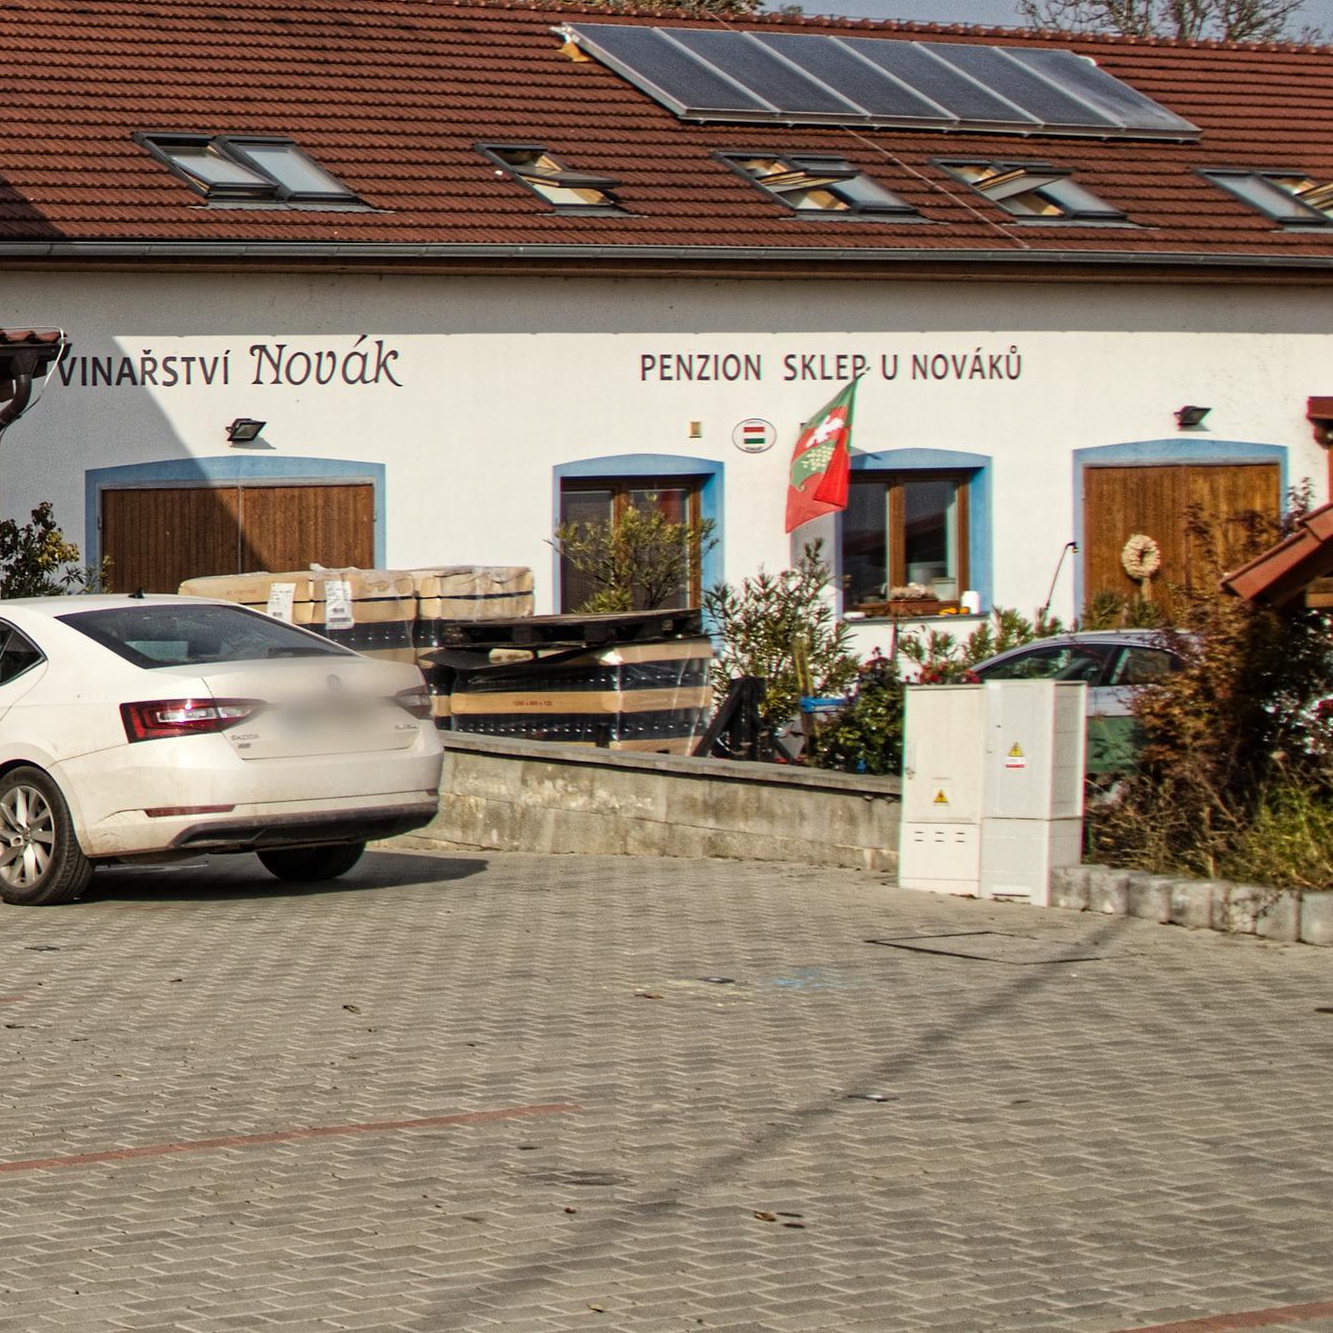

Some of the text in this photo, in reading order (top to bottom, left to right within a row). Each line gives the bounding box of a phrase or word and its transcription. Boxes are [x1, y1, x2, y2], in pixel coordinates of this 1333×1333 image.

[57, 334, 404, 387] VINAŘSTVÍ Novák
[640, 345, 1022, 382] PENZION SKLEP U NOVÁKŮ
